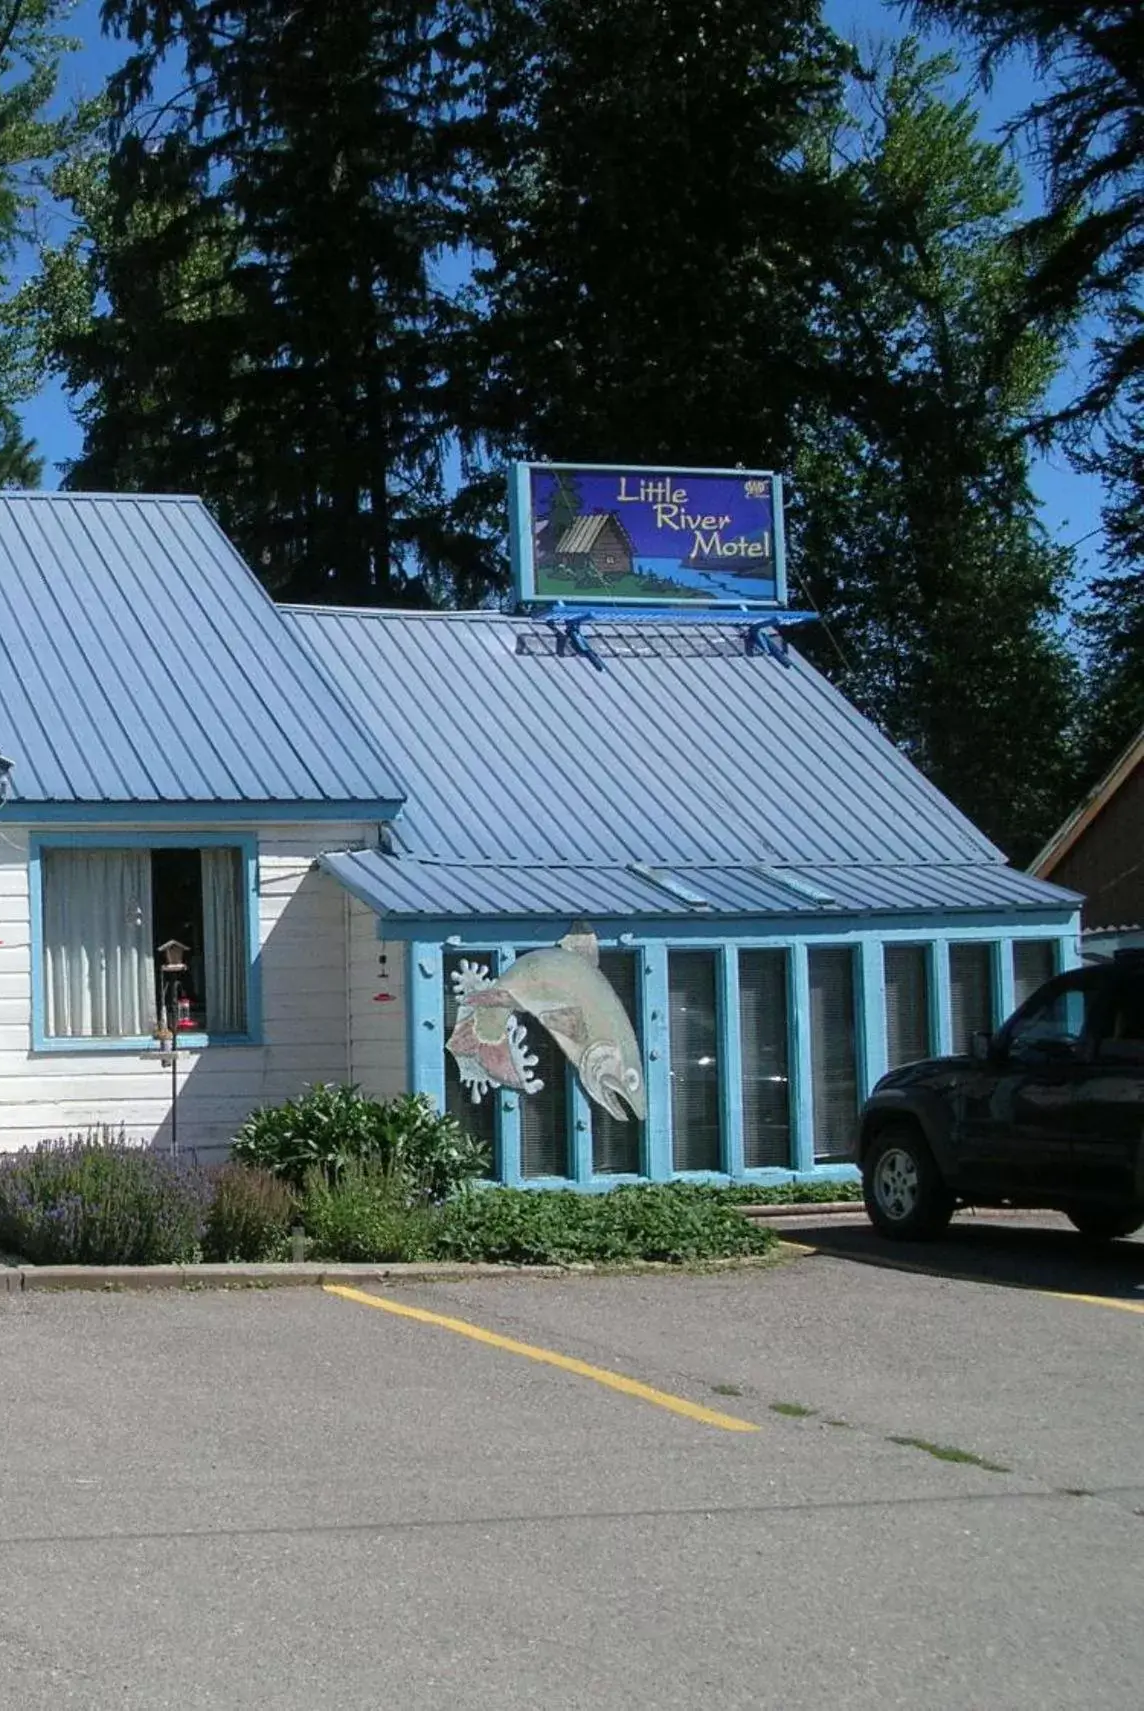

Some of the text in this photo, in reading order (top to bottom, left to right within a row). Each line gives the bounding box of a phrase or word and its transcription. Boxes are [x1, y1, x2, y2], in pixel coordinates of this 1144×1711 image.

[617, 477, 688, 503] Little
[653, 504, 732, 530] River
[690, 531, 770, 558] Motel
